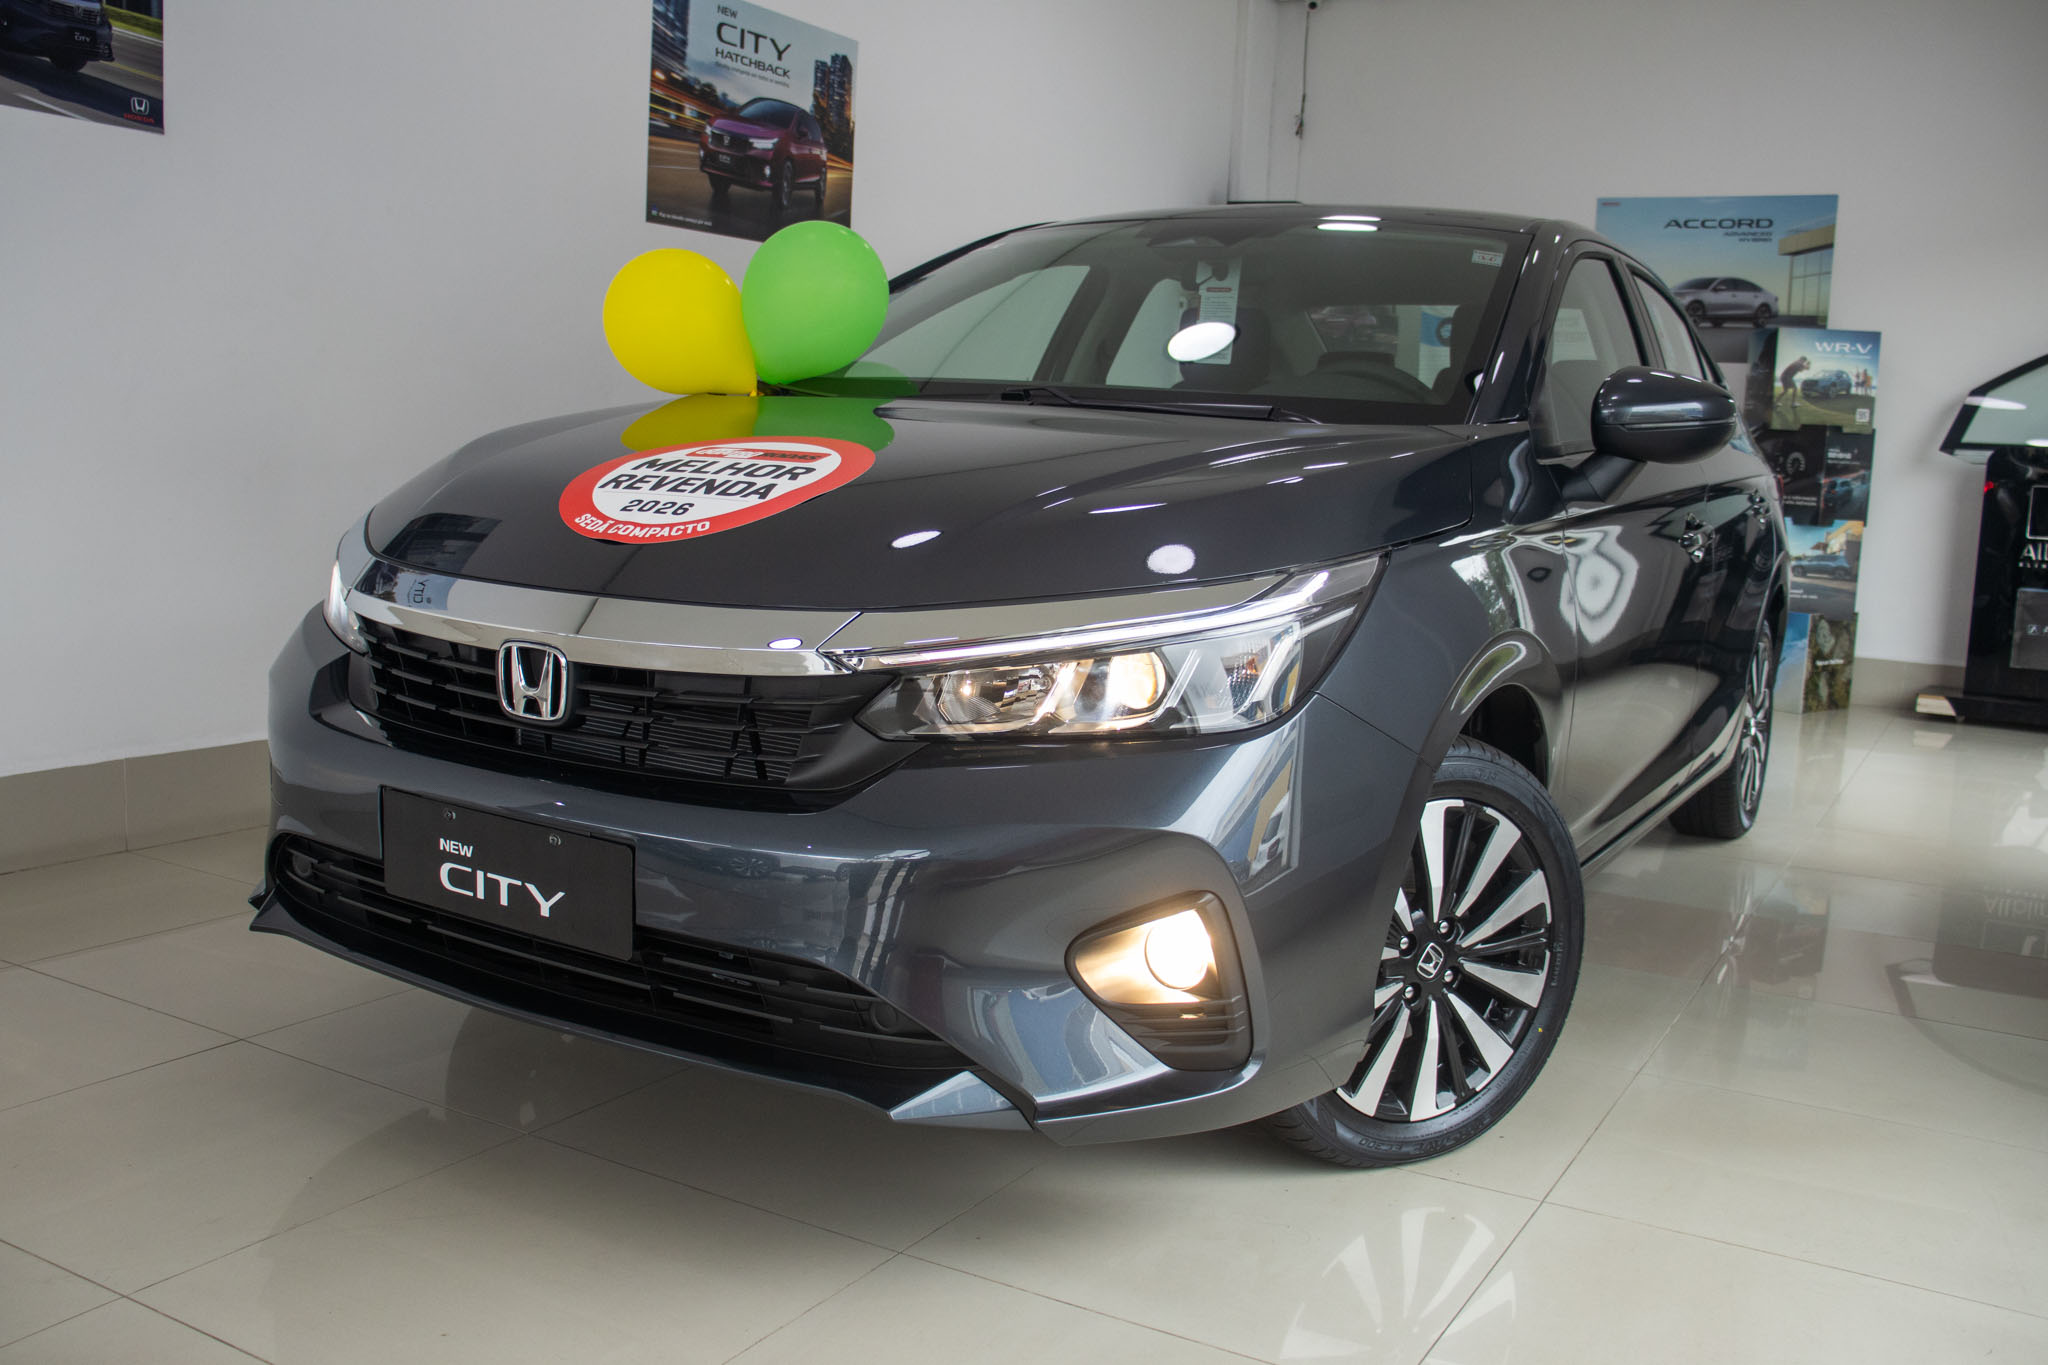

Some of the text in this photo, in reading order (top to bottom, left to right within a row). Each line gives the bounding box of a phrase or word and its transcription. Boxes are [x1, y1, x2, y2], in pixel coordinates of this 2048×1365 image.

[717, 5, 738, 19] NEW
[716, 22, 791, 61] CITY
[715, 47, 790, 79] HATCHBACK
[1664, 218, 1774, 229] ACCORD
[1815, 341, 1873, 354] WR-V
[632, 458, 816, 481] MELHOR
[598, 473, 778, 500] REVENDA
[620, 499, 695, 516] 2026
[608, 521, 711, 538] COMPACTO
[439, 838, 473, 858] NEW
[439, 862, 566, 918] CITY
